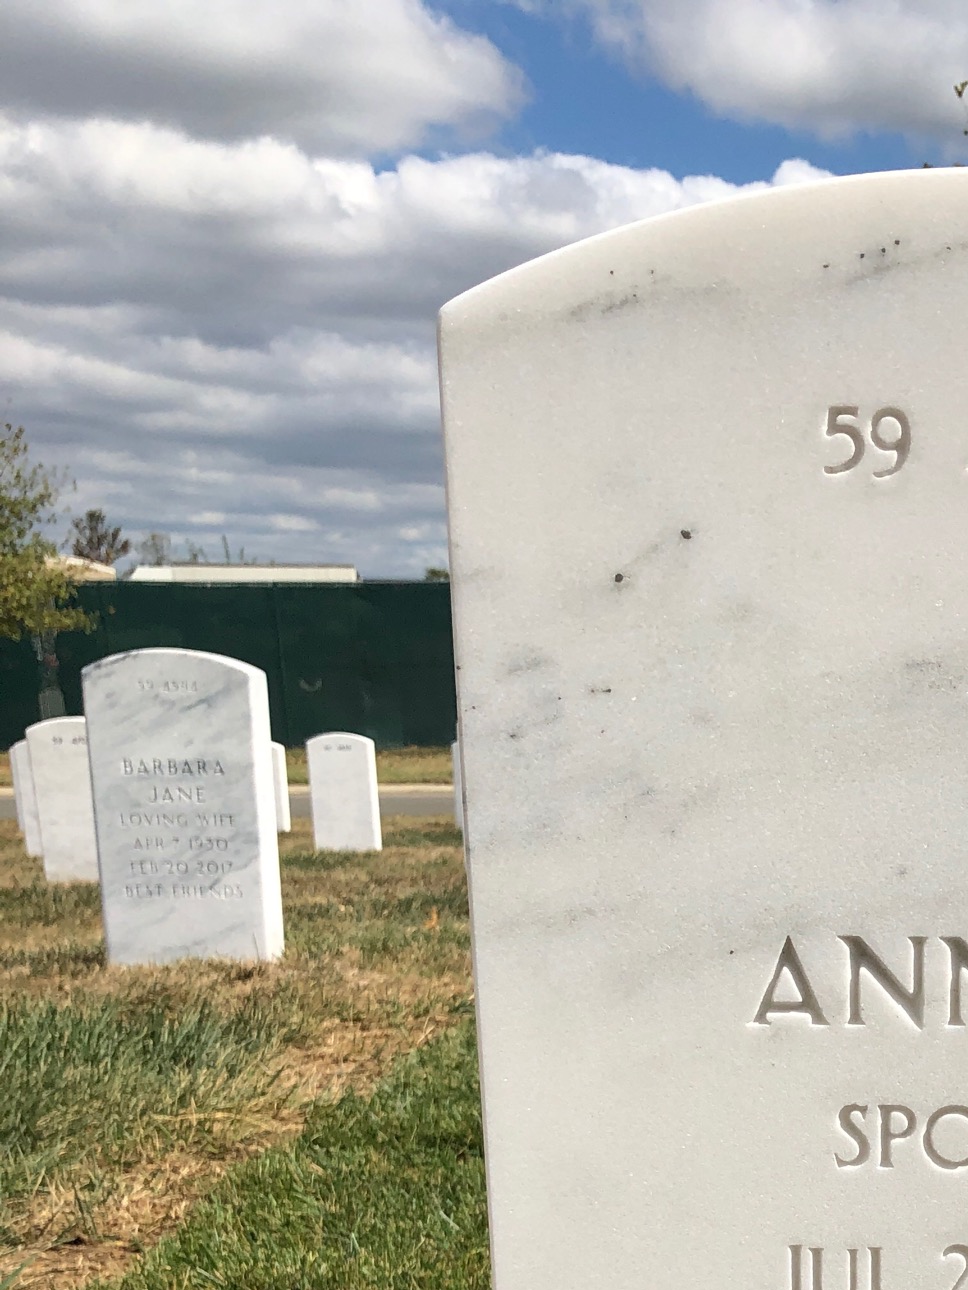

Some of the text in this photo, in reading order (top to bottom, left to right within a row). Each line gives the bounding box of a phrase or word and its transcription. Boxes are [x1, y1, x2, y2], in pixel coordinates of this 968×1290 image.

[823, 404, 912, 479] 59
[122, 757, 226, 777] BARBARA
[149, 785, 207, 804] JANE
[120, 812, 236, 828] LOVING WIFE
[133, 836, 165, 851] APR
[163, 859, 189, 875] 20
[172, 883, 244, 899] FRIENDS
